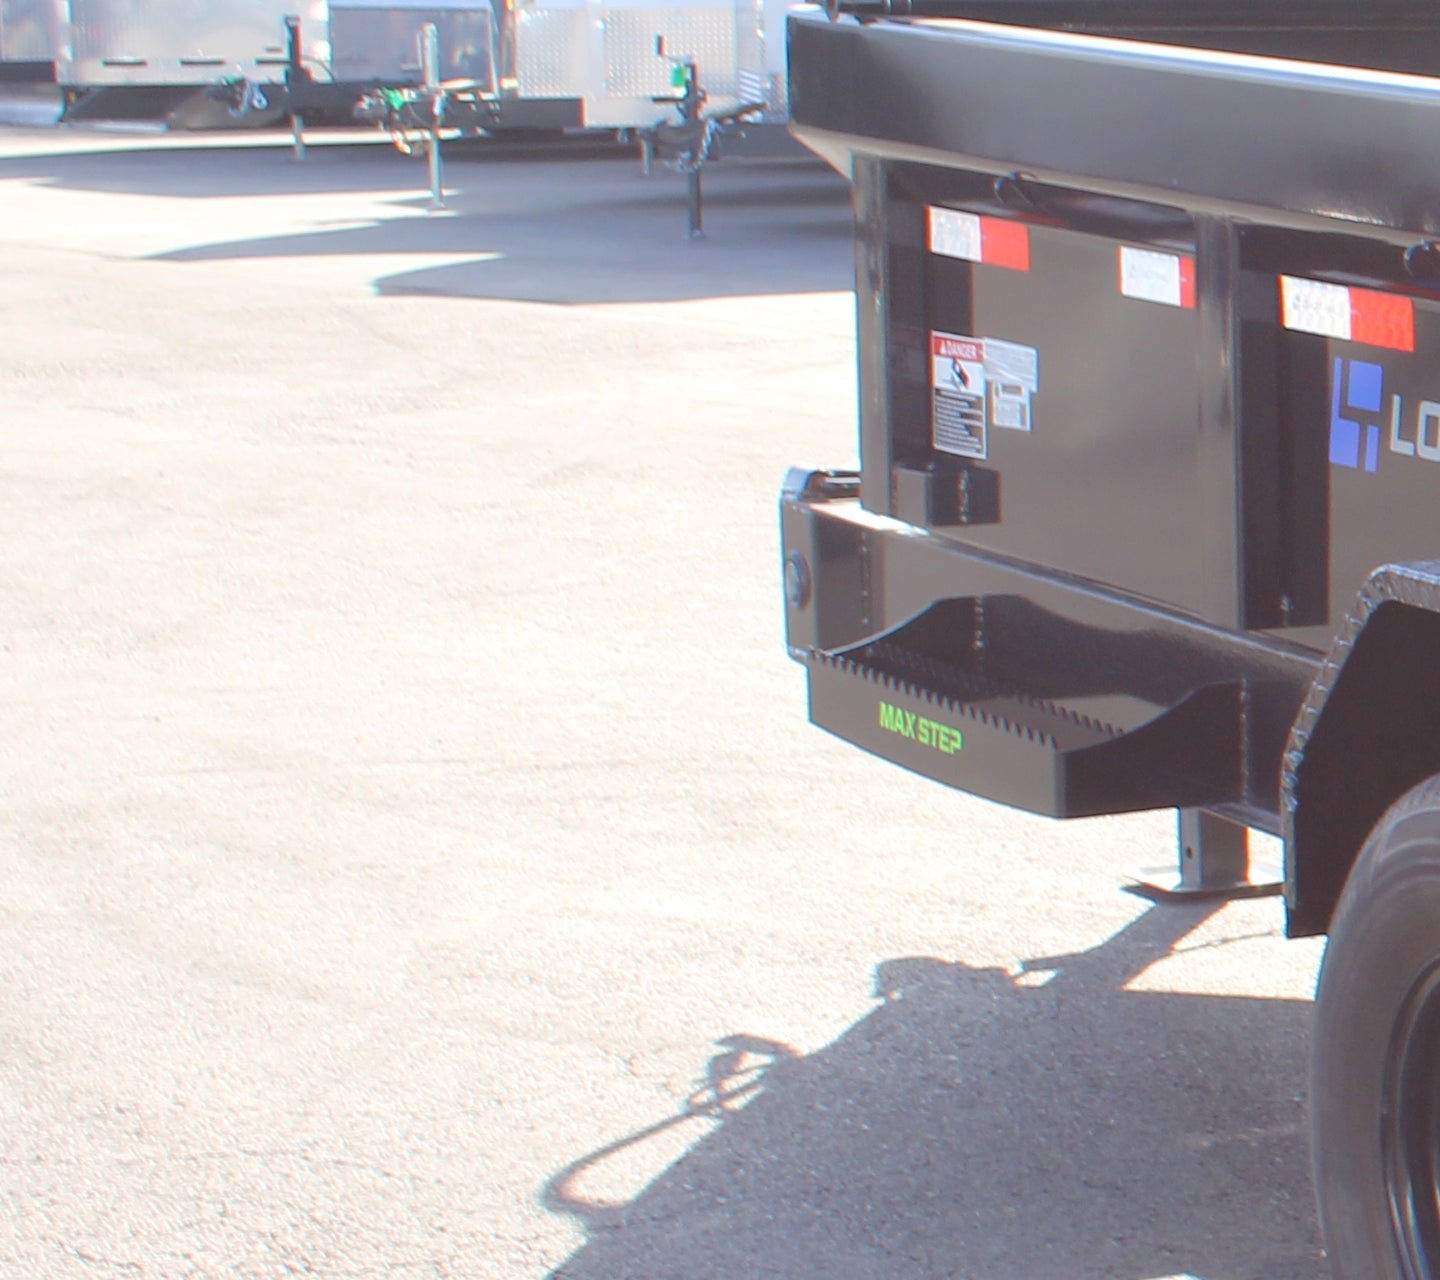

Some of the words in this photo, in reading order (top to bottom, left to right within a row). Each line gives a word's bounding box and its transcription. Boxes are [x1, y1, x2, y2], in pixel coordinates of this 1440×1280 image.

[946, 339, 978, 359] DANGER
[880, 701, 916, 740] MAX
[919, 715, 963, 755] STEP
